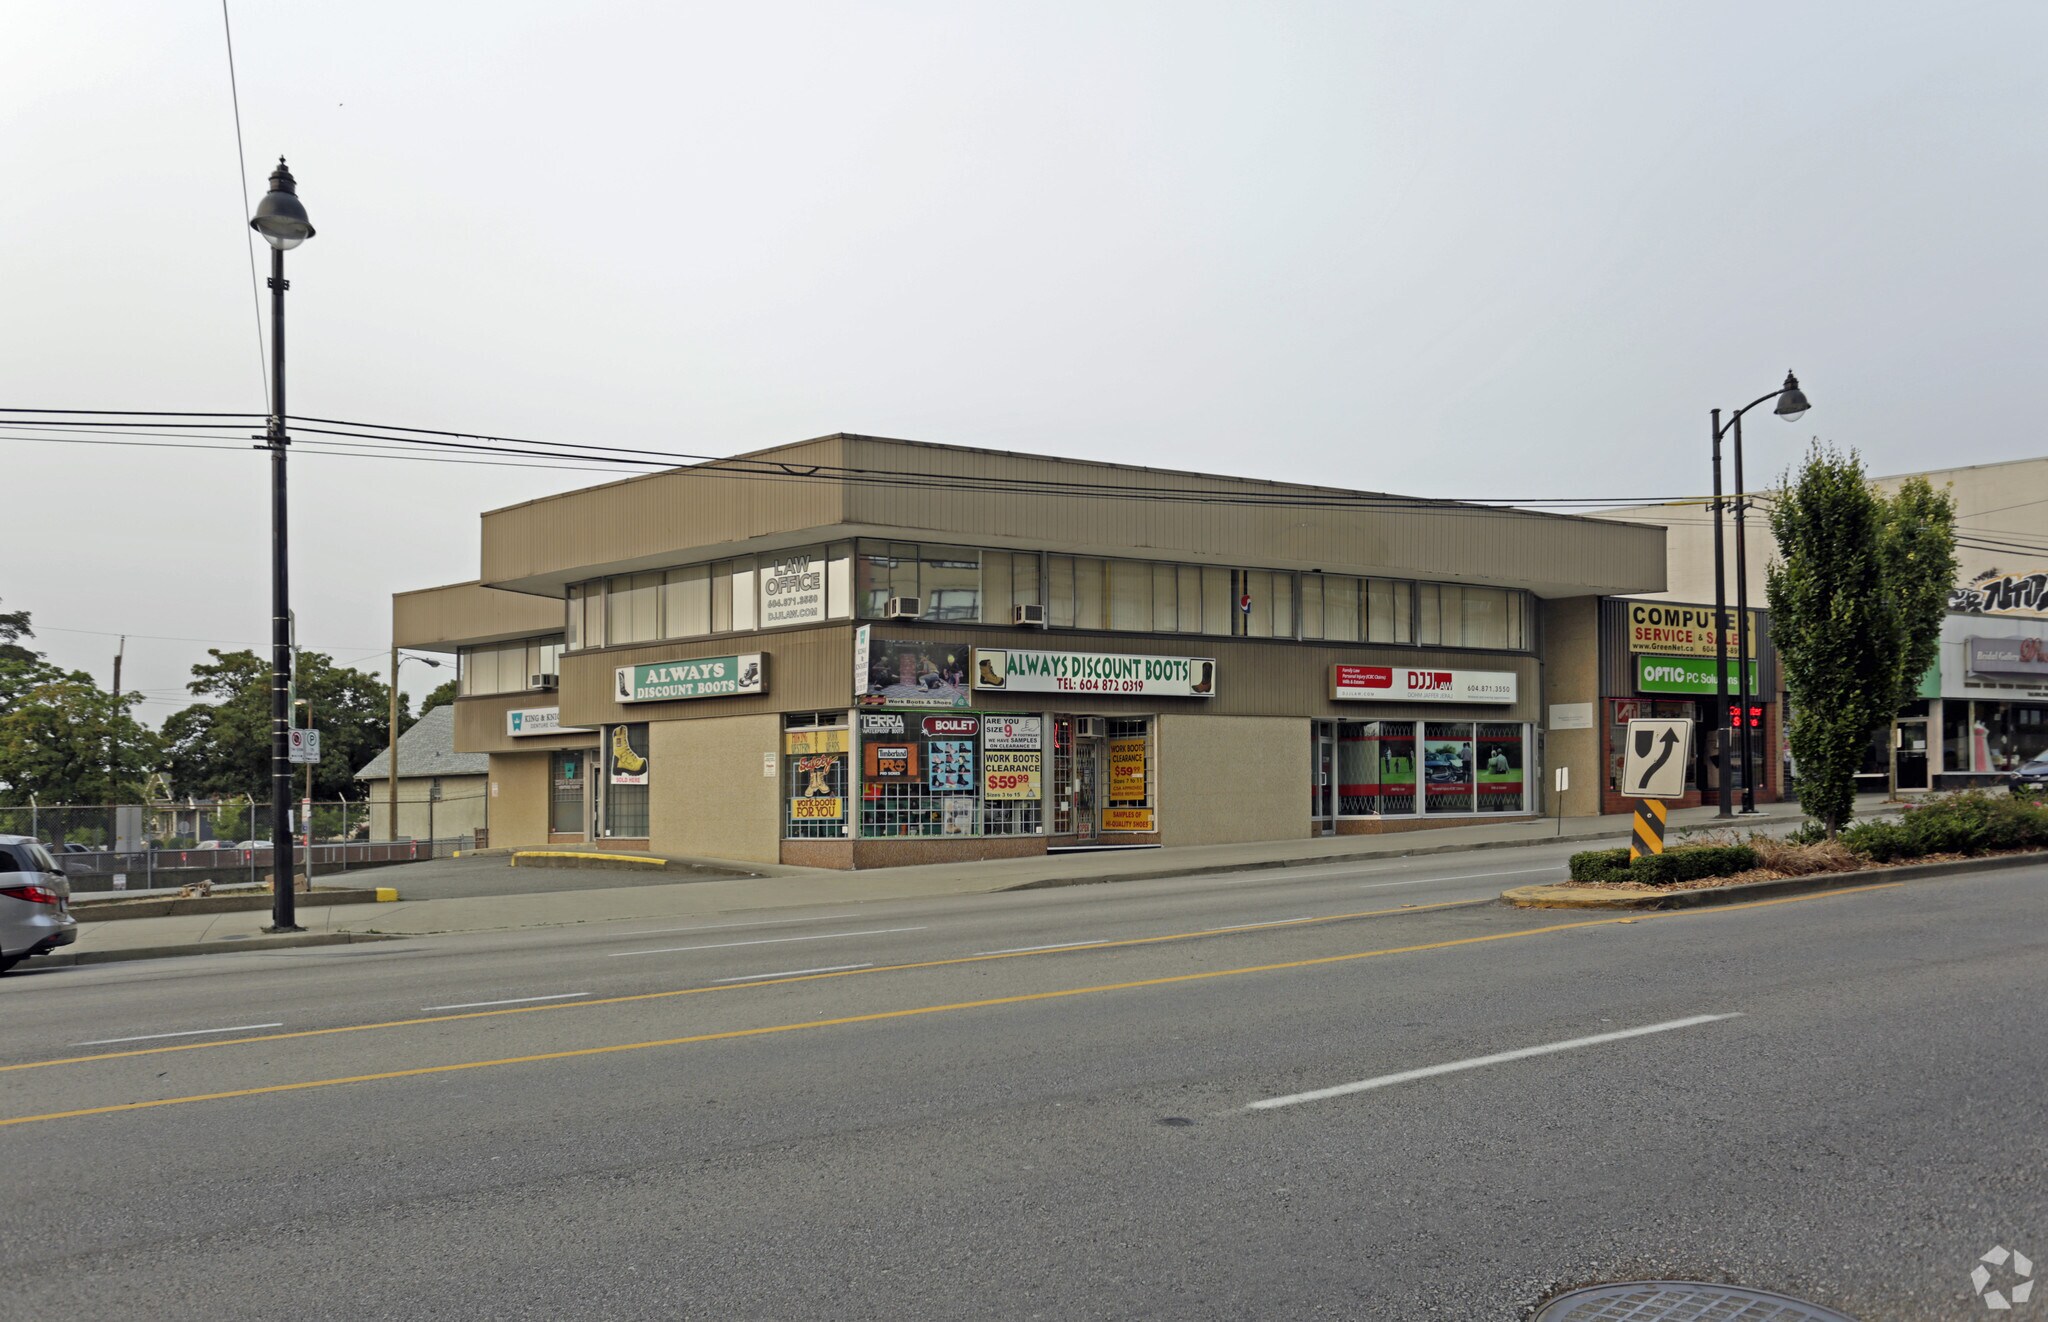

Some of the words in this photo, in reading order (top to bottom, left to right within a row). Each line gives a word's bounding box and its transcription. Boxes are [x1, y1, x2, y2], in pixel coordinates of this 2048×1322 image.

[774, 555, 811, 576] LAW
[765, 572, 820, 595] OFFICE
[1635, 627, 1693, 643] SERVICE
[1698, 633, 1704, 641] &
[1632, 642, 1694, 652] www.GreenNet.ca
[1976, 650, 1998, 660] Bridal
[646, 663, 725, 684] ALWAYS
[1007, 653, 1067, 677] ALWAYS
[1071, 656, 1141, 681] DISCOUNT
[1145, 659, 1188, 681] BOOTS
[1644, 666, 1685, 683] OPTIC
[1686, 672, 1699, 683] PC
[637, 683, 694, 699] DISCOUNT
[697, 680, 735, 695] BOOTS
[1056, 678, 1076, 690] TEL:
[1079, 679, 1099, 691] 604
[1102, 680, 1119, 692] 872
[1122, 680, 1144, 692] 0319
[1467, 685, 1511, 693] 604.871.3550
[860, 714, 904, 729] TERRA
[935, 720, 975, 731] BOULET
[1004, 724, 1013, 737] 9
[879, 749, 907, 758] Timberland
[1111, 745, 1126, 753] WORK
[1127, 744, 1145, 752] BOOTS
[799, 754, 838, 775] Safety
[986, 754, 1011, 763] WORK
[1013, 754, 1040, 763] BOOTS
[1112, 754, 1142, 763] CLEARANCE
[797, 806, 814, 817] FOR
[815, 806, 835, 817] YOU
